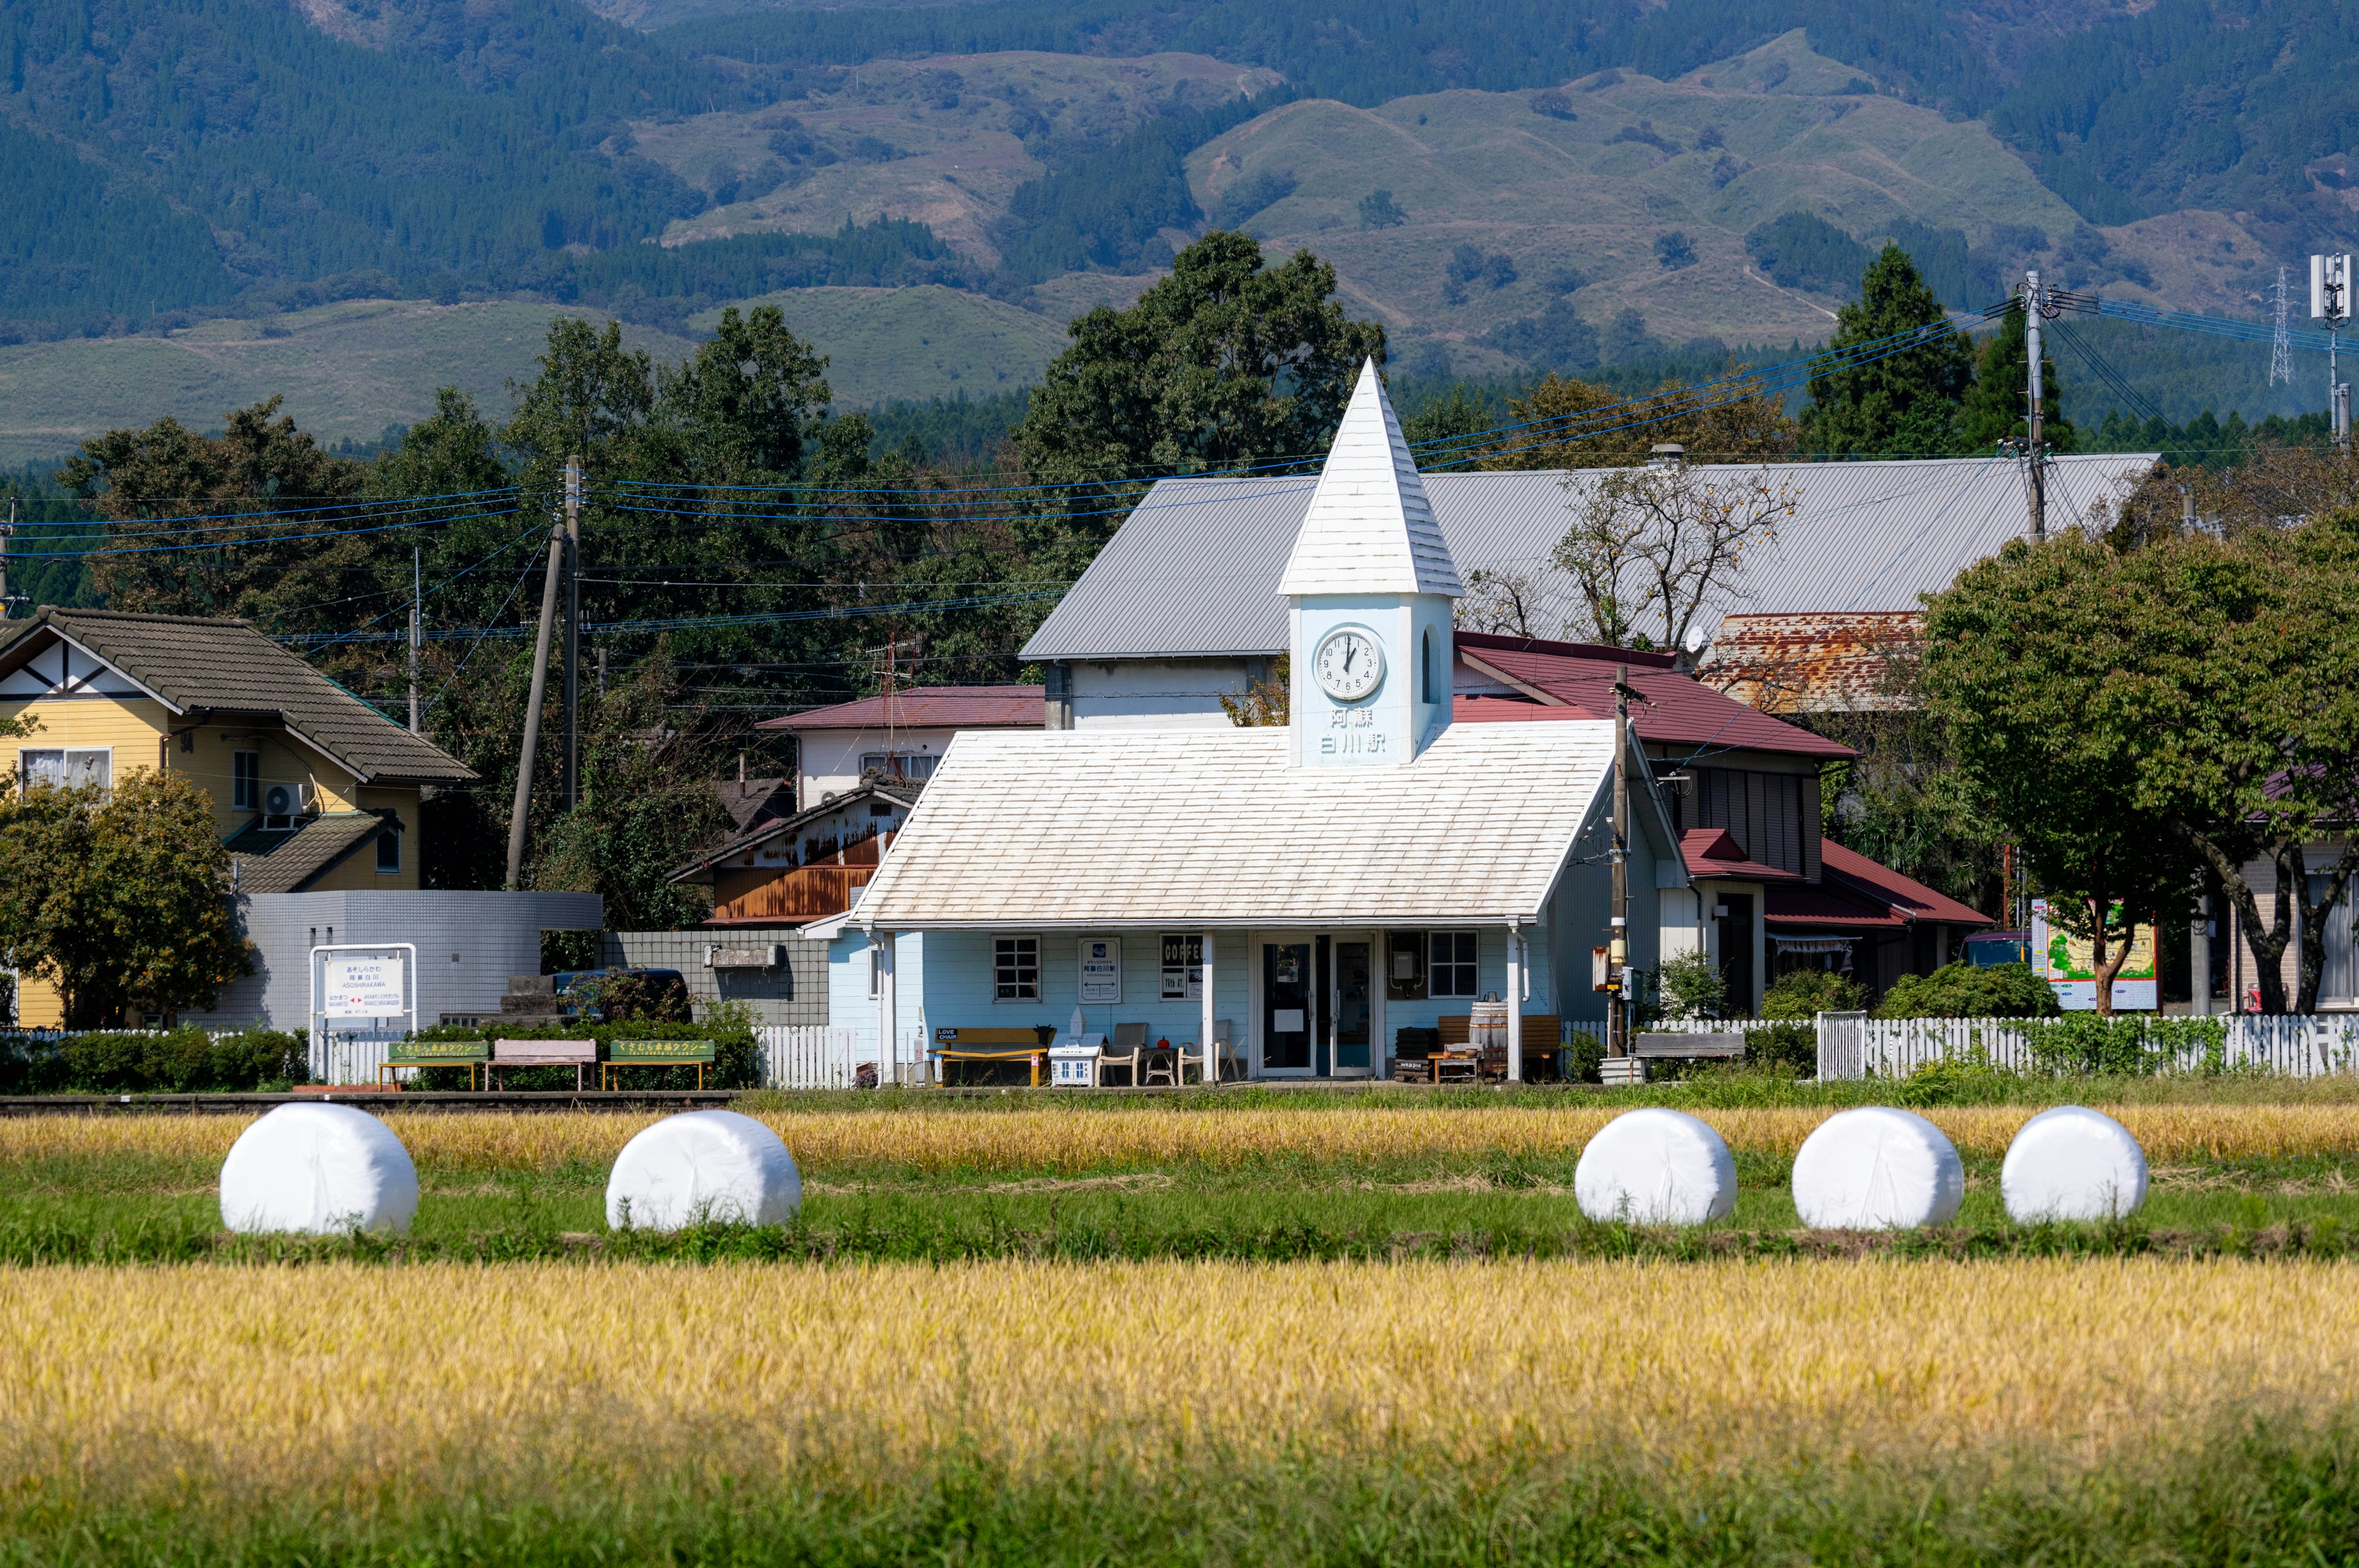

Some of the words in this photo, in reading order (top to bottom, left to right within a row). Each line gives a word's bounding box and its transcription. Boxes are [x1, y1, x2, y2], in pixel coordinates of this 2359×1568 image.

[1334, 639, 1340, 648] 11
[1326, 648, 1332, 657] 10
[1364, 647, 1369, 656] 2
[1326, 671, 1332, 679] 8
[1335, 679, 1340, 688] 7
[1345, 682, 1351, 690] 6
[1331, 706, 1373, 728] 阿蘇
[1320, 731, 1385, 754] 白川駅
[619, 1042, 708, 1051] くさむら幸福タクシー
